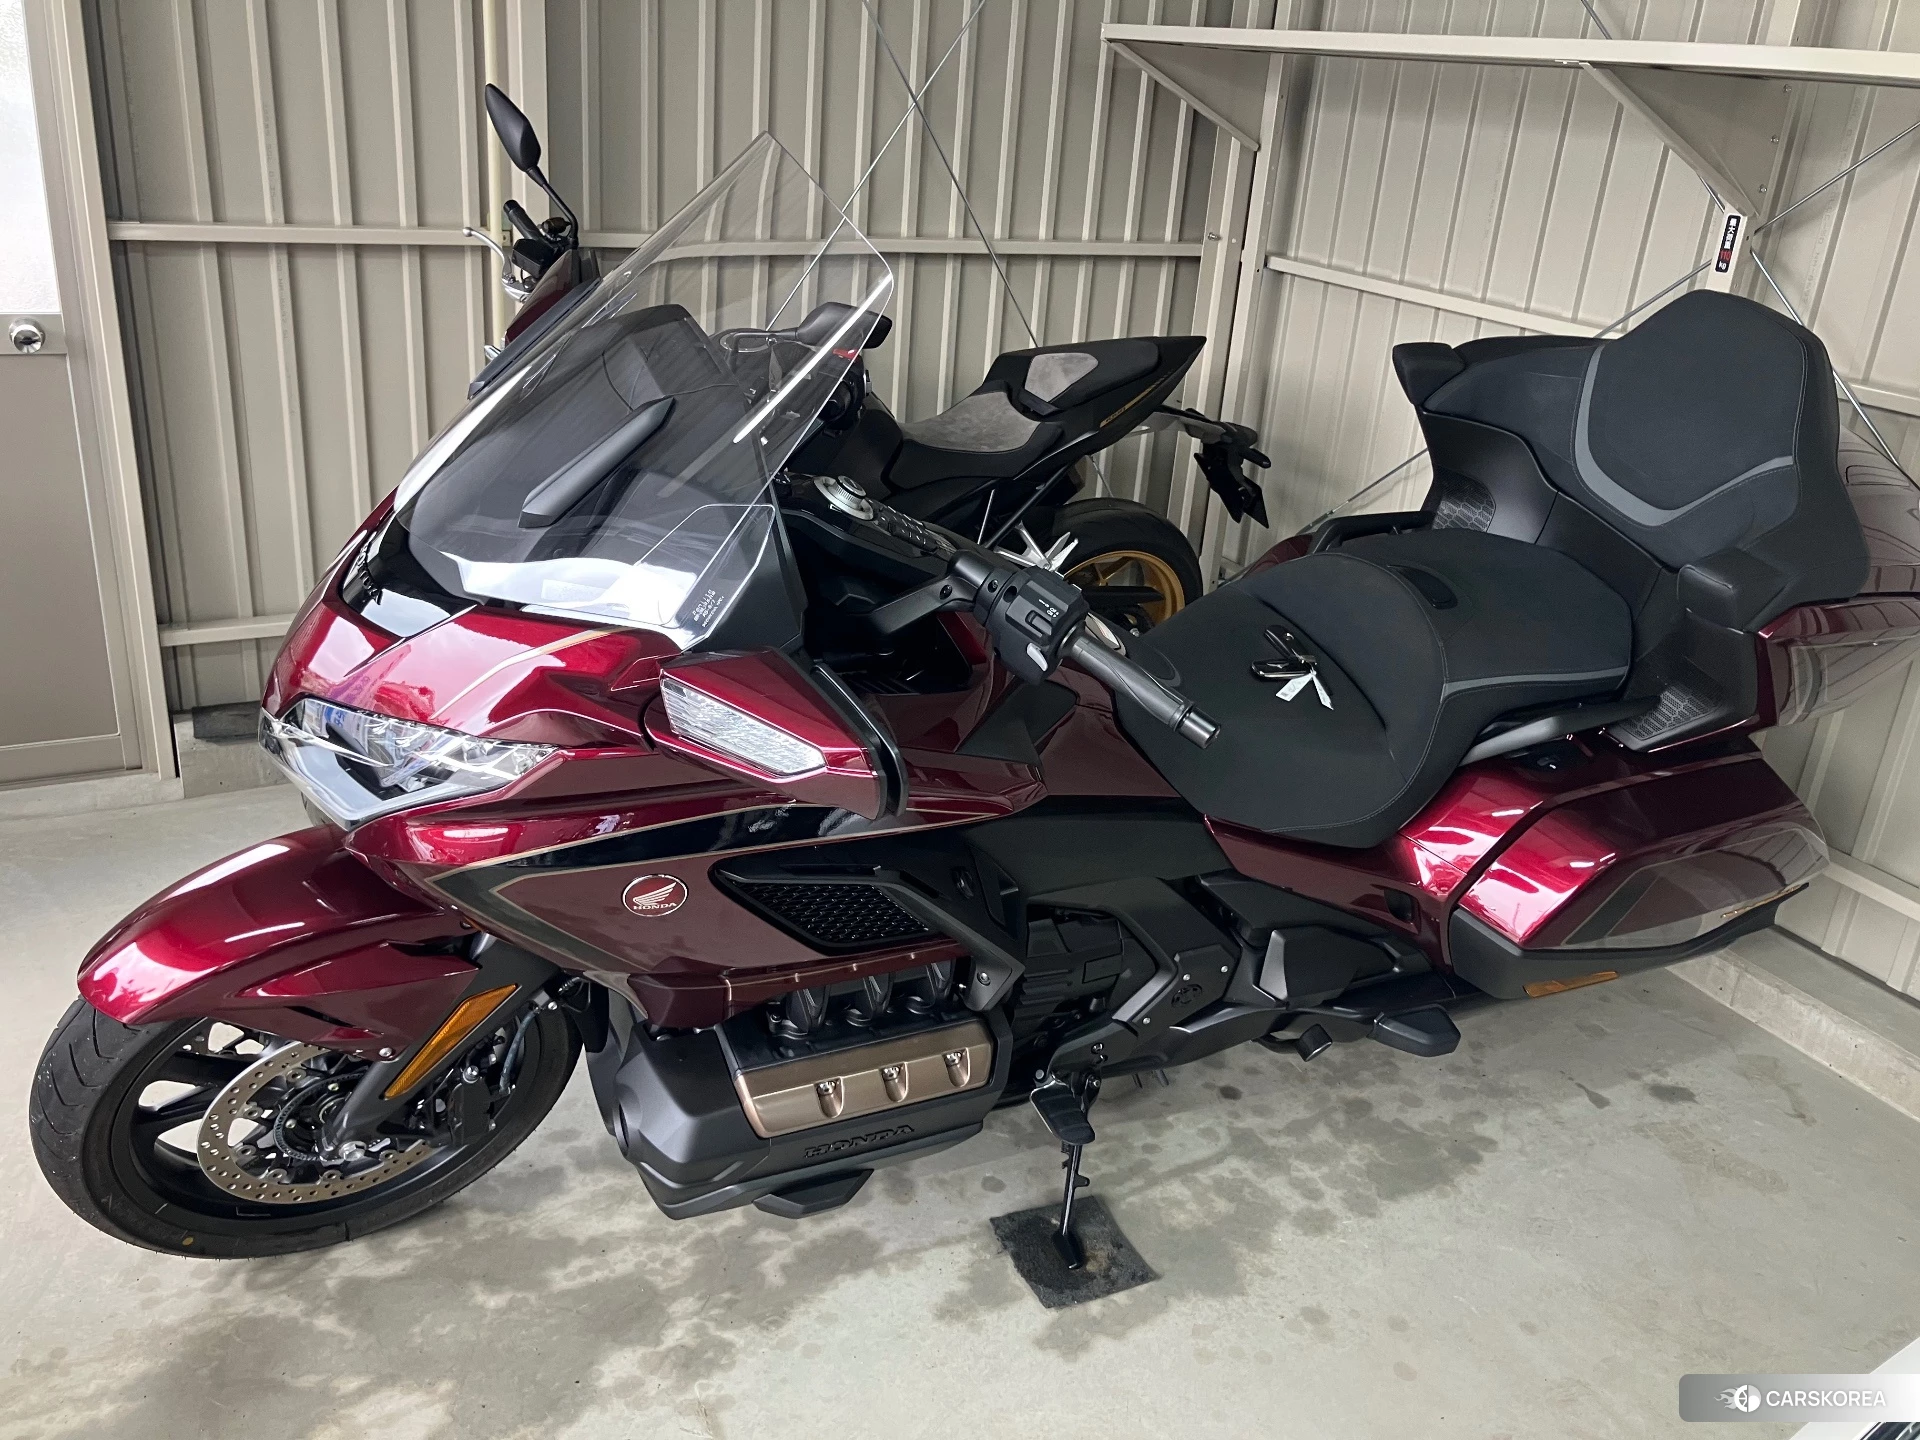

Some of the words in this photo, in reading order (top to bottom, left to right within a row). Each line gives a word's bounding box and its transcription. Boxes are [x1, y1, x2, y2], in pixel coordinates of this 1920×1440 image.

[1719, 261, 1727, 270] kg
[633, 902, 677, 910] HONDA
[804, 1124, 915, 1158] HONDA
